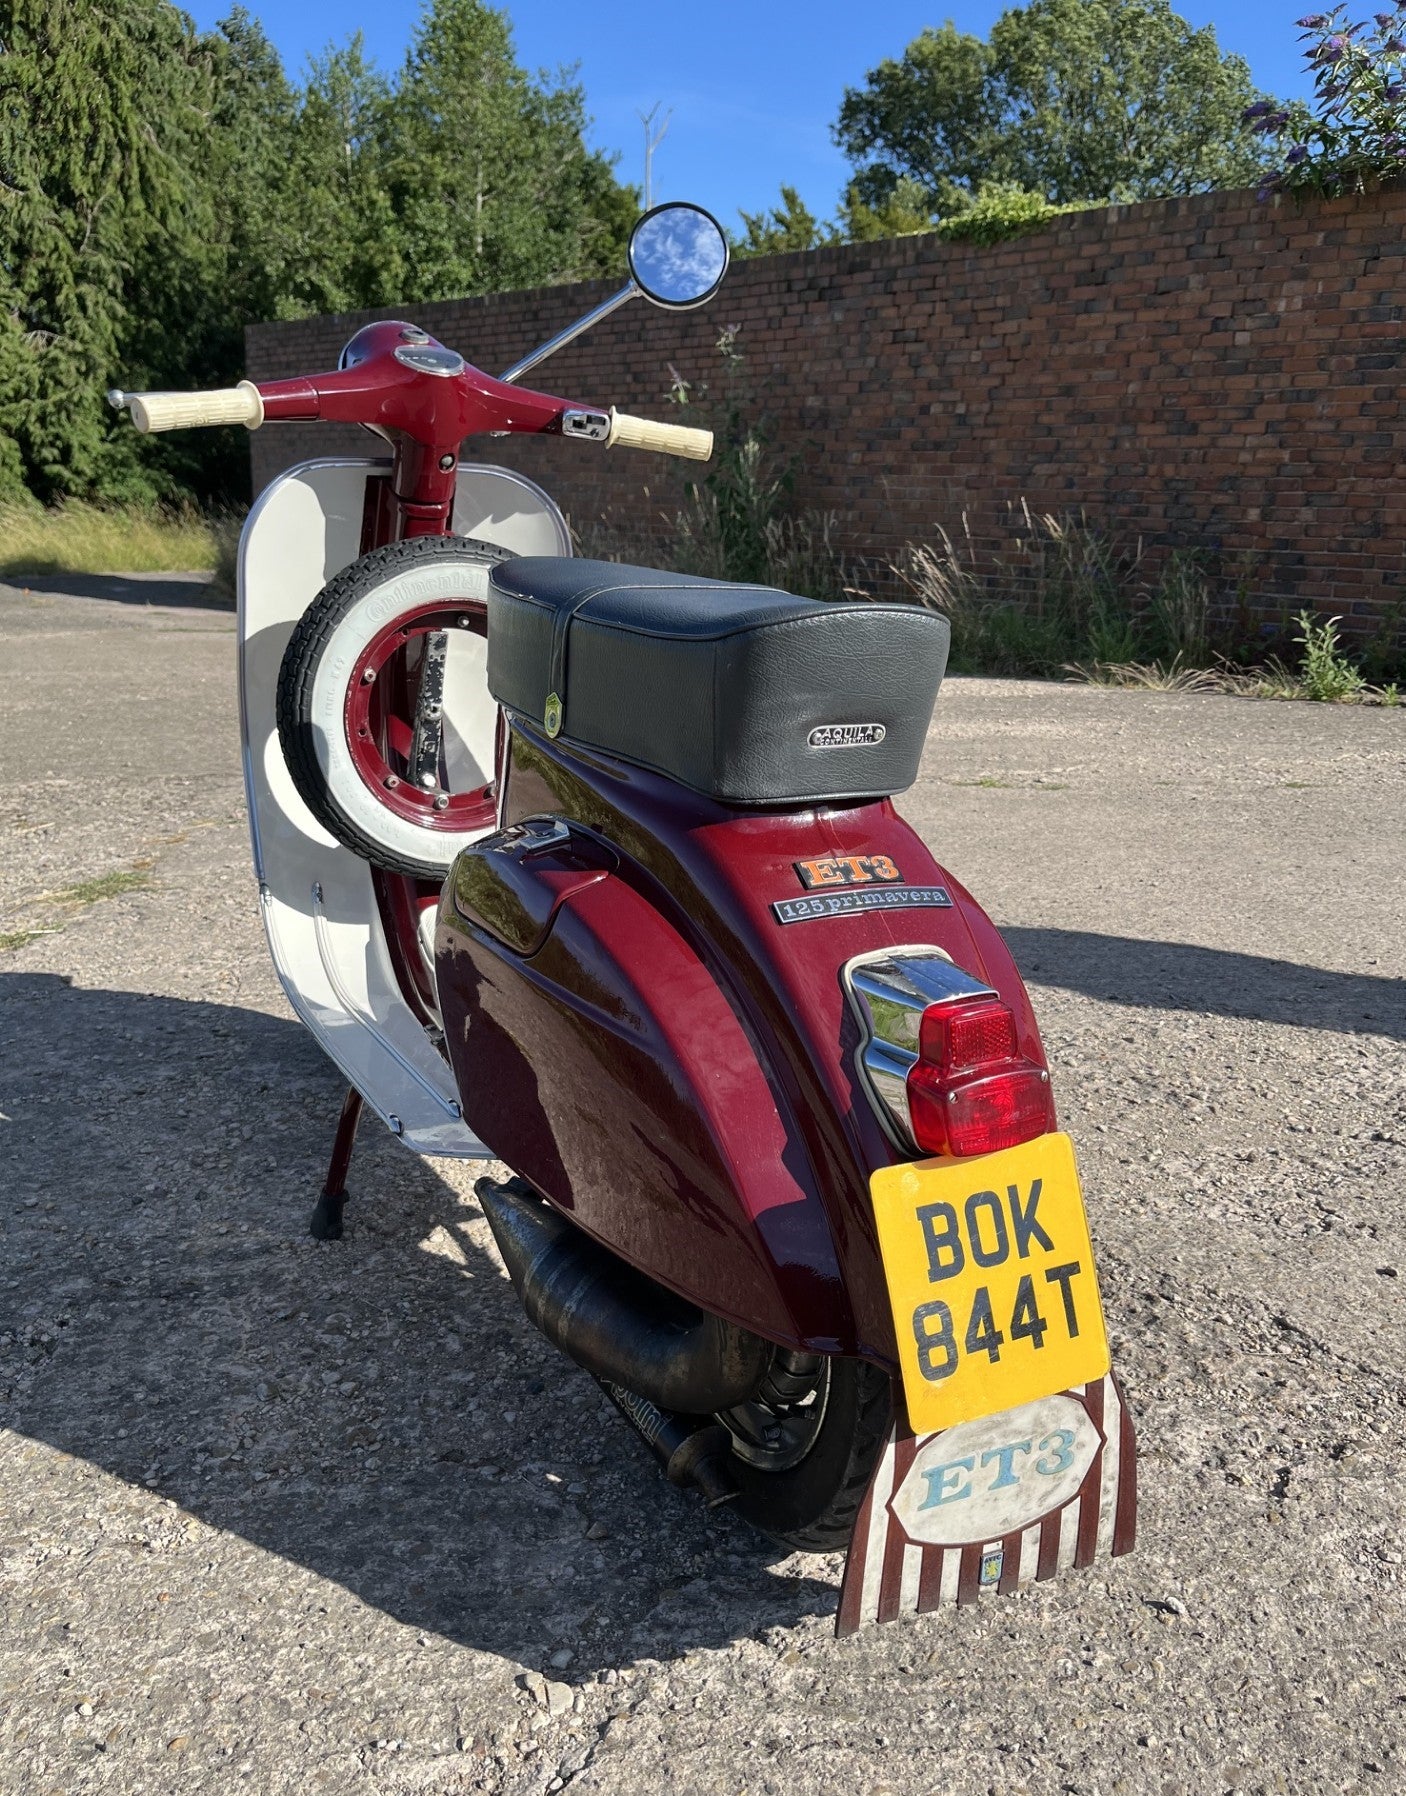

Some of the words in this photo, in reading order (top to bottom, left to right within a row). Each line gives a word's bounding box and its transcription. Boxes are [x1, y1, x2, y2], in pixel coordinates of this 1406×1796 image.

[364, 571, 484, 623] Continental
[820, 726, 873, 739] AQUILA
[802, 855, 899, 885] ET3
[783, 899, 825, 918] 125
[826, 889, 946, 912] primavera
[915, 1178, 1056, 1283] BOK
[912, 1260, 1081, 1381] 844T
[917, 1429, 1076, 1512] ET3
